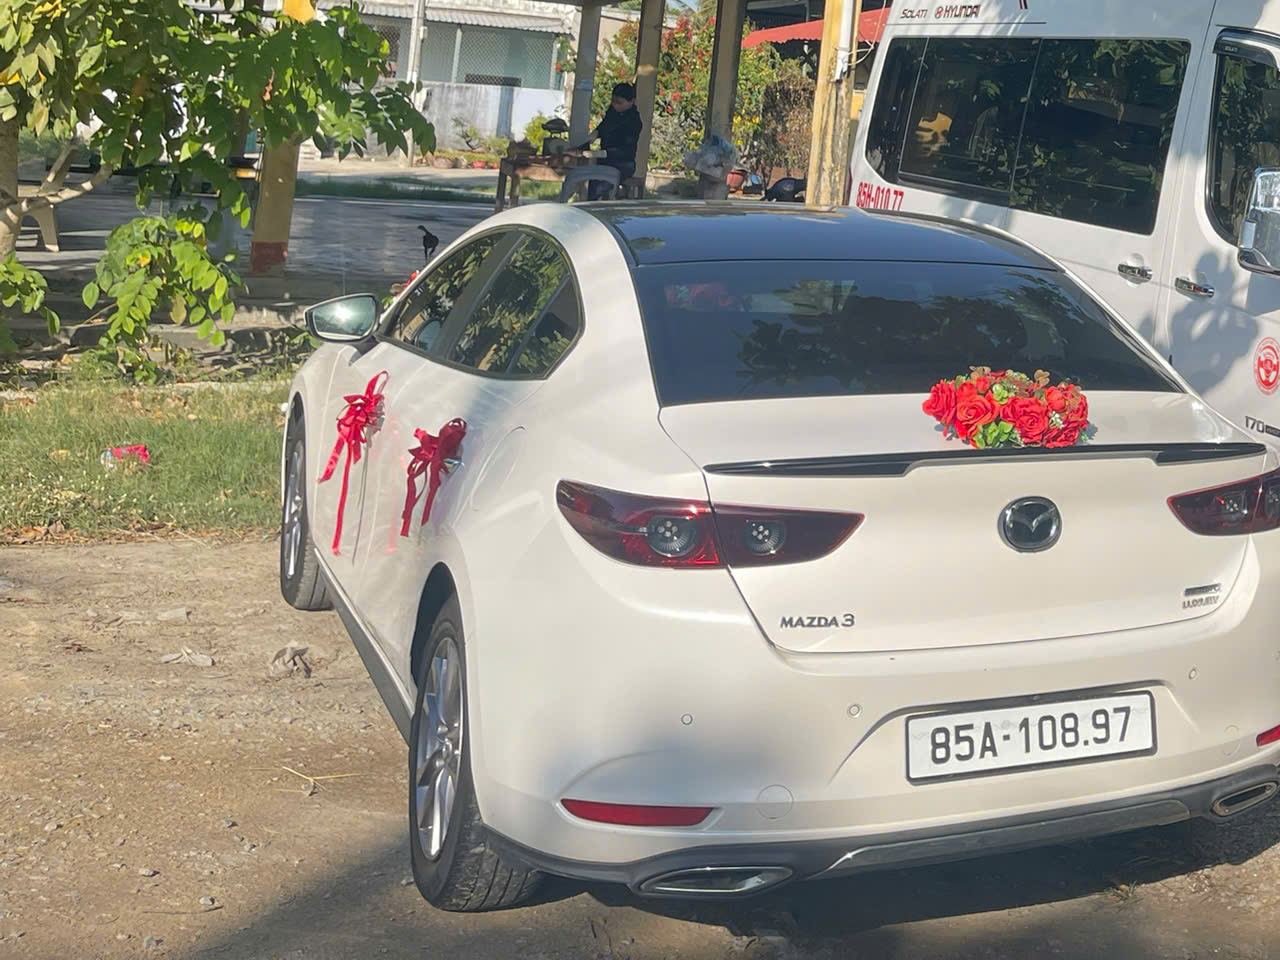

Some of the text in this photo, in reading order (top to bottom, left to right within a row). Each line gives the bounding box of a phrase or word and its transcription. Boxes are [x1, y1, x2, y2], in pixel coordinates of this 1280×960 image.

[900, 9, 928, 19] SOLATI
[943, 5, 980, 18] HYUNDAI
[1245, 416, 1264, 433] 170
[931, 706, 1131, 764] 85A-108.97
